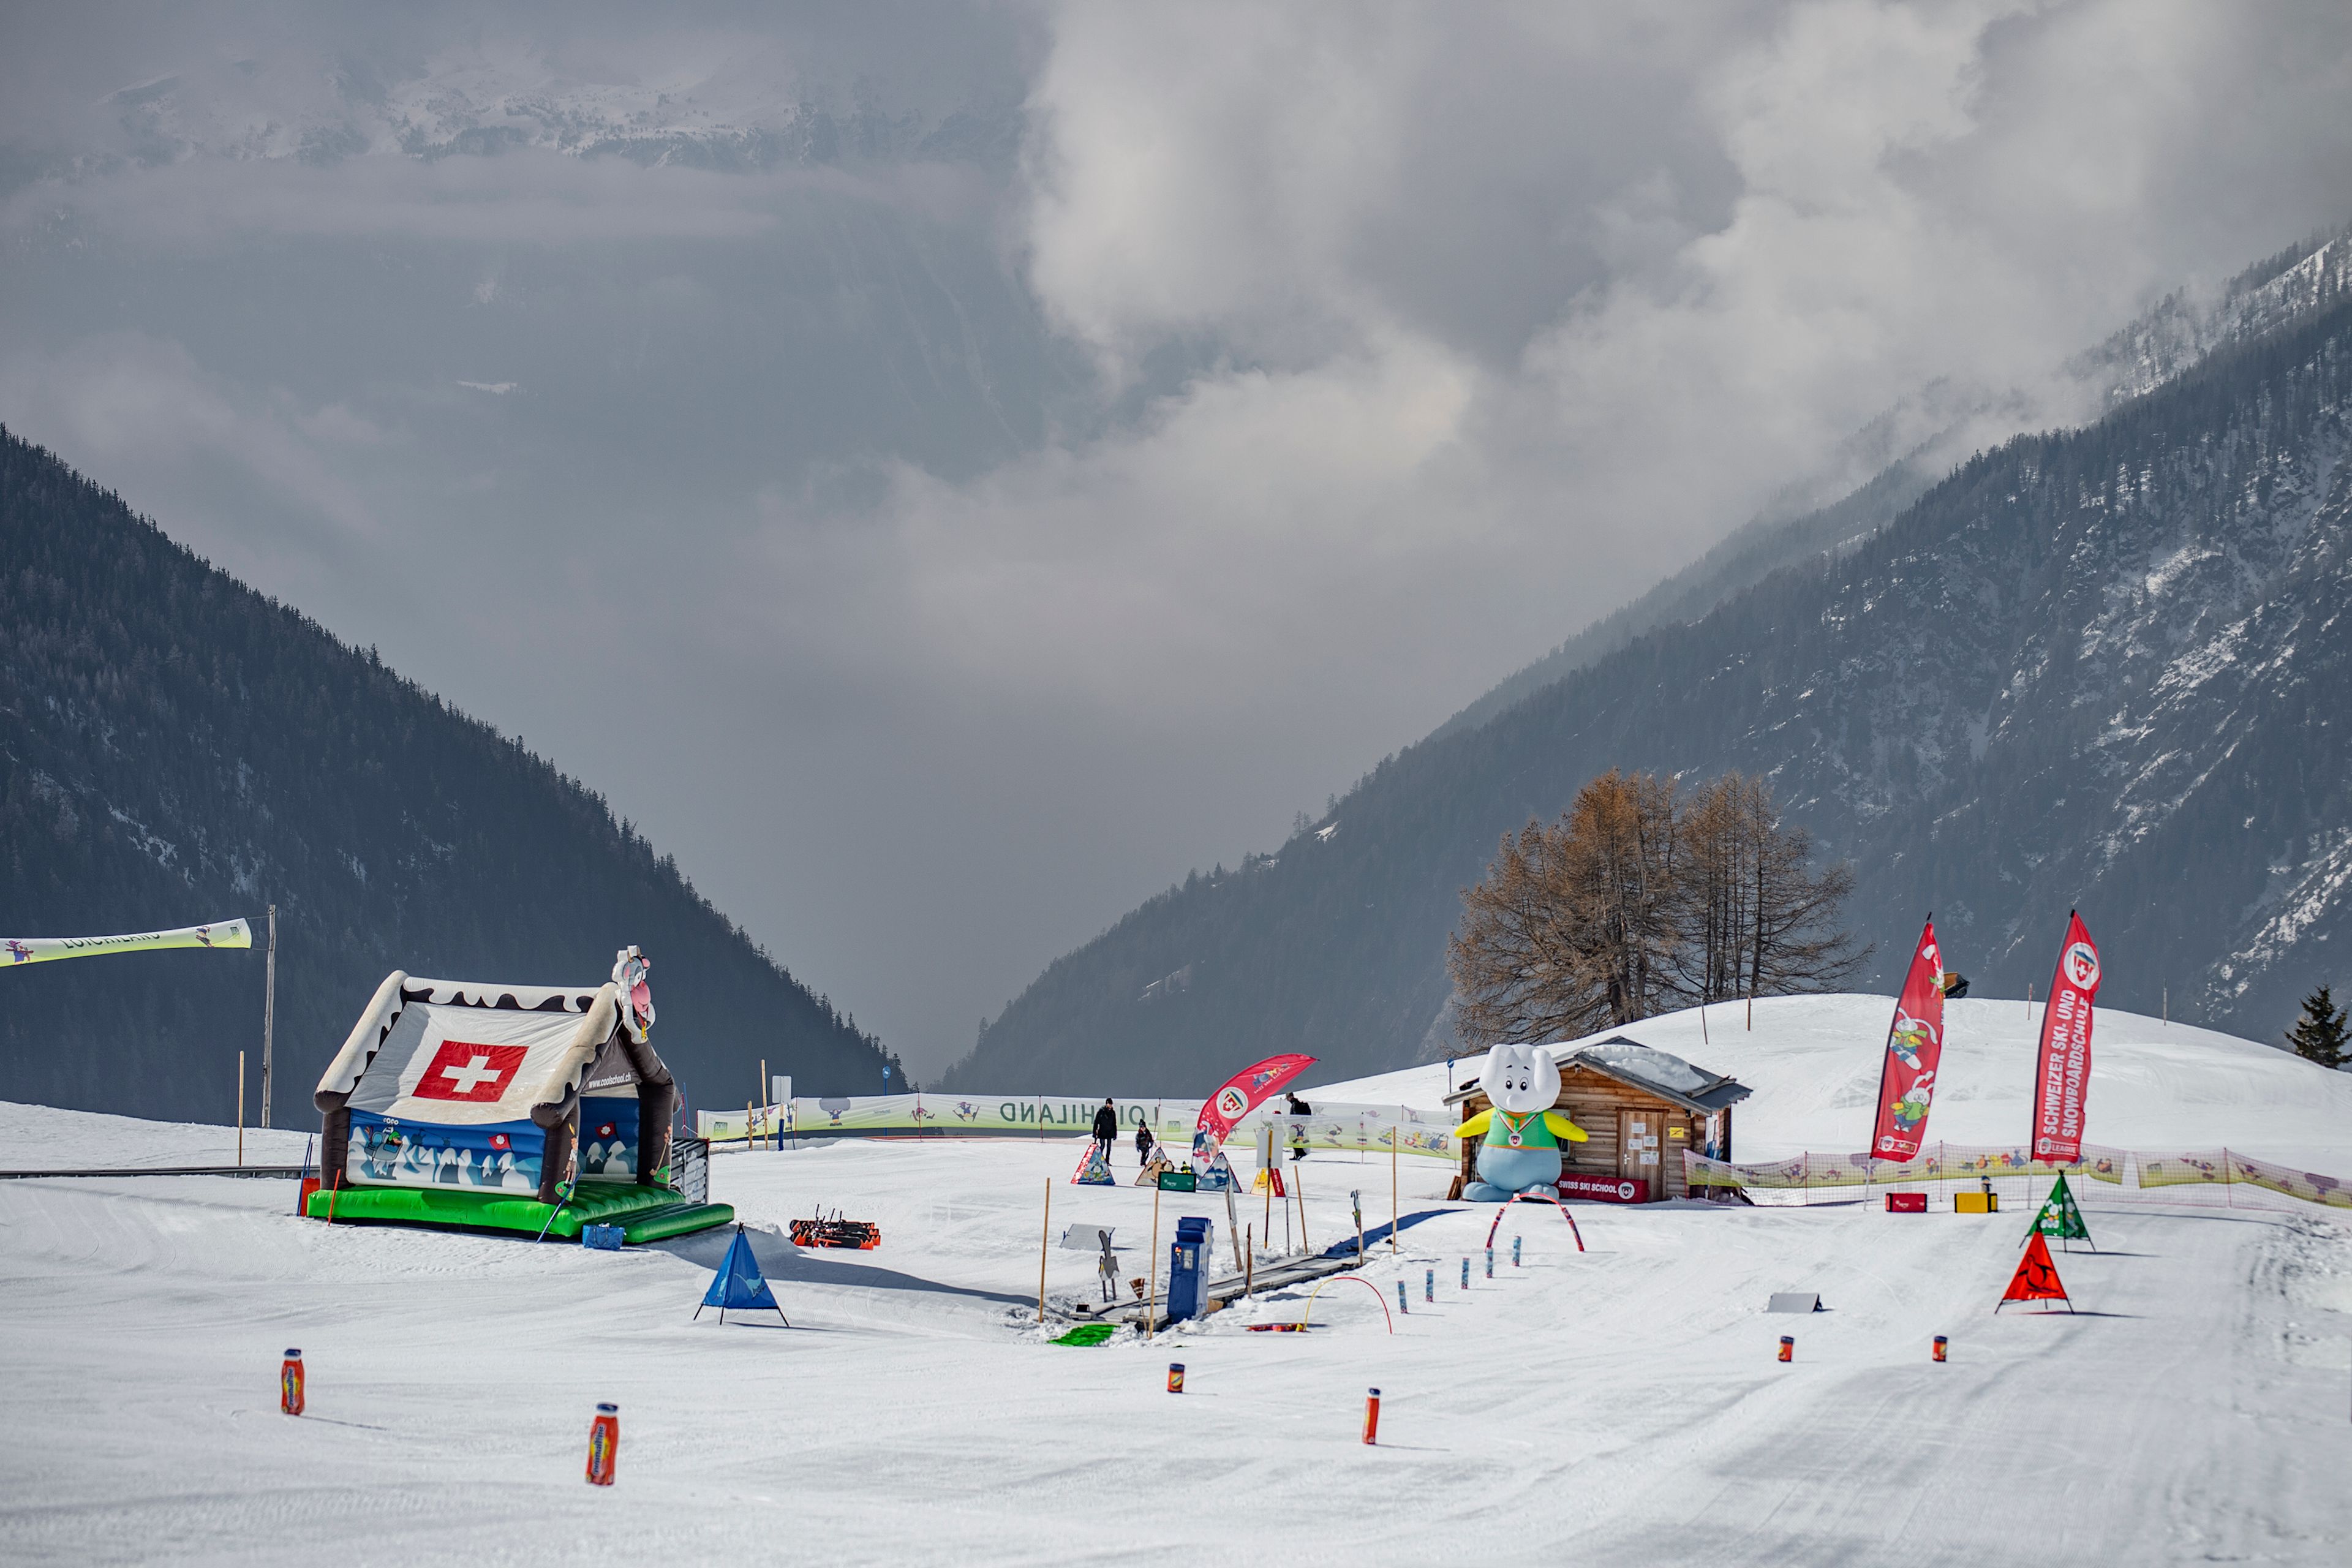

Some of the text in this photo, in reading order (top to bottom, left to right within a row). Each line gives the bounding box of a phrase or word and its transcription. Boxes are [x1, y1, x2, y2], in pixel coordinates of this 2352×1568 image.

[2043, 989, 2076, 1135] SCHWEIZER SKI- UND
[589, 1071, 631, 1088] www.coolschool.ch
[2052, 1144, 2076, 1154] LEAGUE
[1558, 1180, 1618, 1194] SWISS SKI SCHOOL
